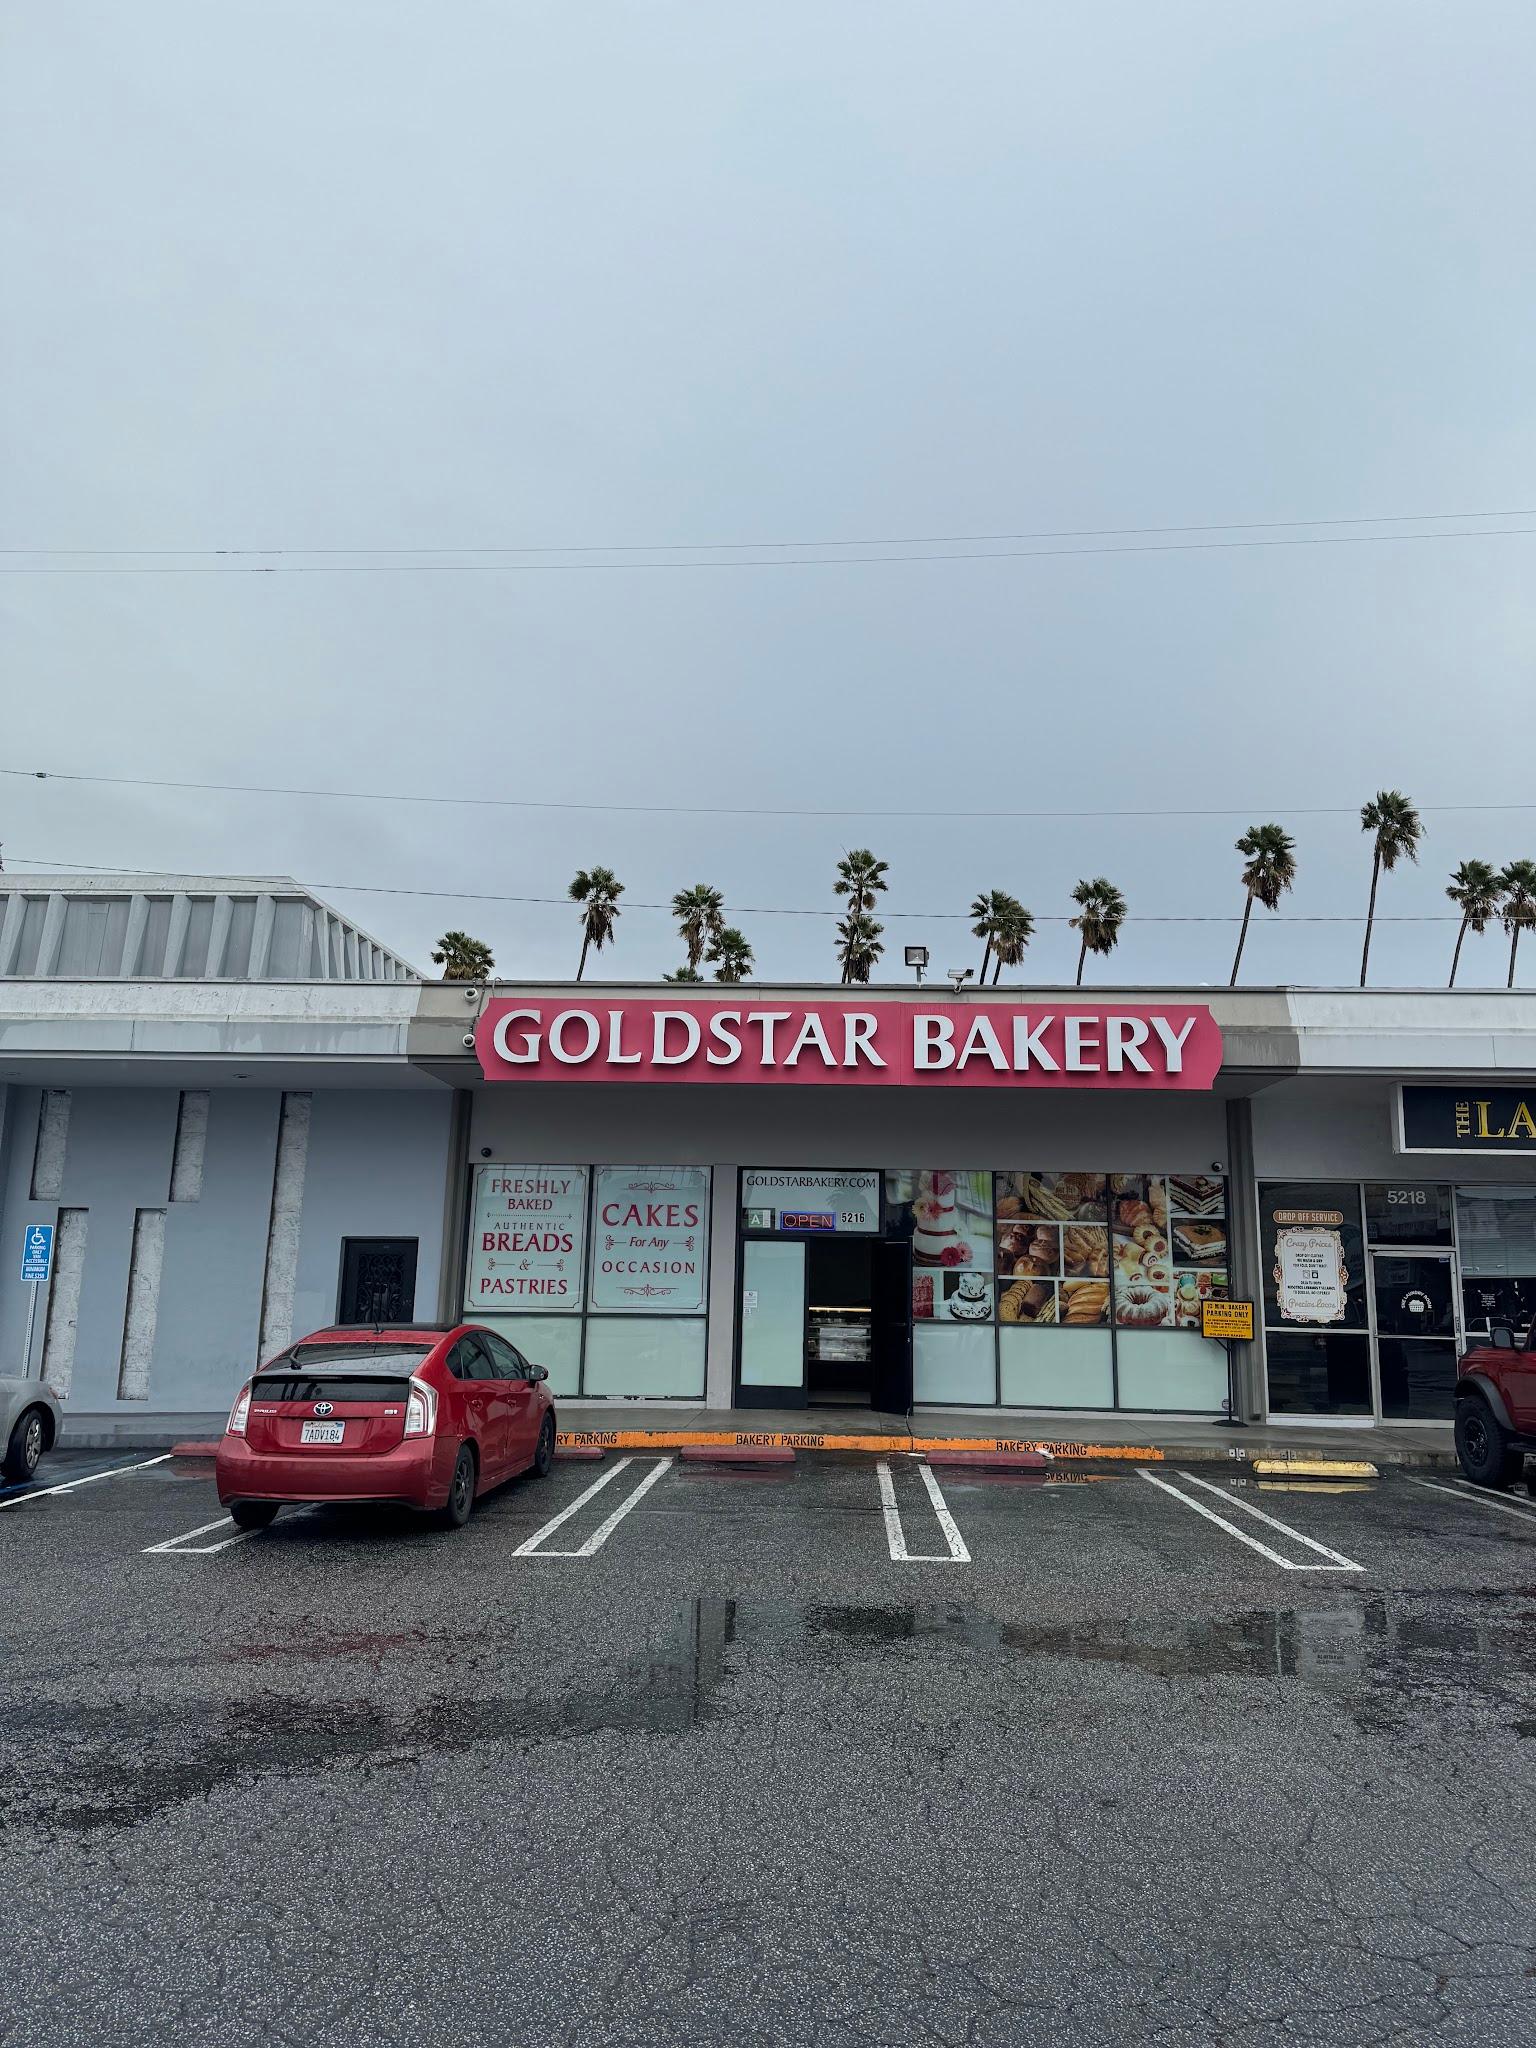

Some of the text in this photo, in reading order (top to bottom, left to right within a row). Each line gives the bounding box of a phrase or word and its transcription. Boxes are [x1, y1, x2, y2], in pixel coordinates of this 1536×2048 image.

[493, 1009, 1197, 1072] GOLDSTAR BAKERY
[1456, 1101, 1470, 1138] THE
[491, 1179, 571, 1194] FRESHLY
[746, 1175, 876, 1188] GOLDSTARBAKERY.COM
[508, 1198, 553, 1210] BAKED
[1387, 1190, 1426, 1204] 5218
[602, 1203, 699, 1228] CAKES
[750, 1214, 761, 1225] A
[784, 1214, 832, 1228] OPEN
[841, 1212, 865, 1223] 5216
[1278, 1212, 1338, 1222] DROP OFF SERVICE
[493, 1222, 565, 1231] AUTHENTIC
[482, 1232, 573, 1253] BREADS
[629, 1236, 669, 1251] For Any
[519, 1259, 534, 1271] &
[601, 1260, 695, 1274] OCCASION
[480, 1278, 567, 1295] PASTRIES
[304, 1429, 340, 1440] 7ADV184
[574, 1434, 617, 1445] PARKING
[736, 1434, 825, 1447] BAKERY PARKING
[996, 1441, 1087, 1456] BAKERY PARKING
